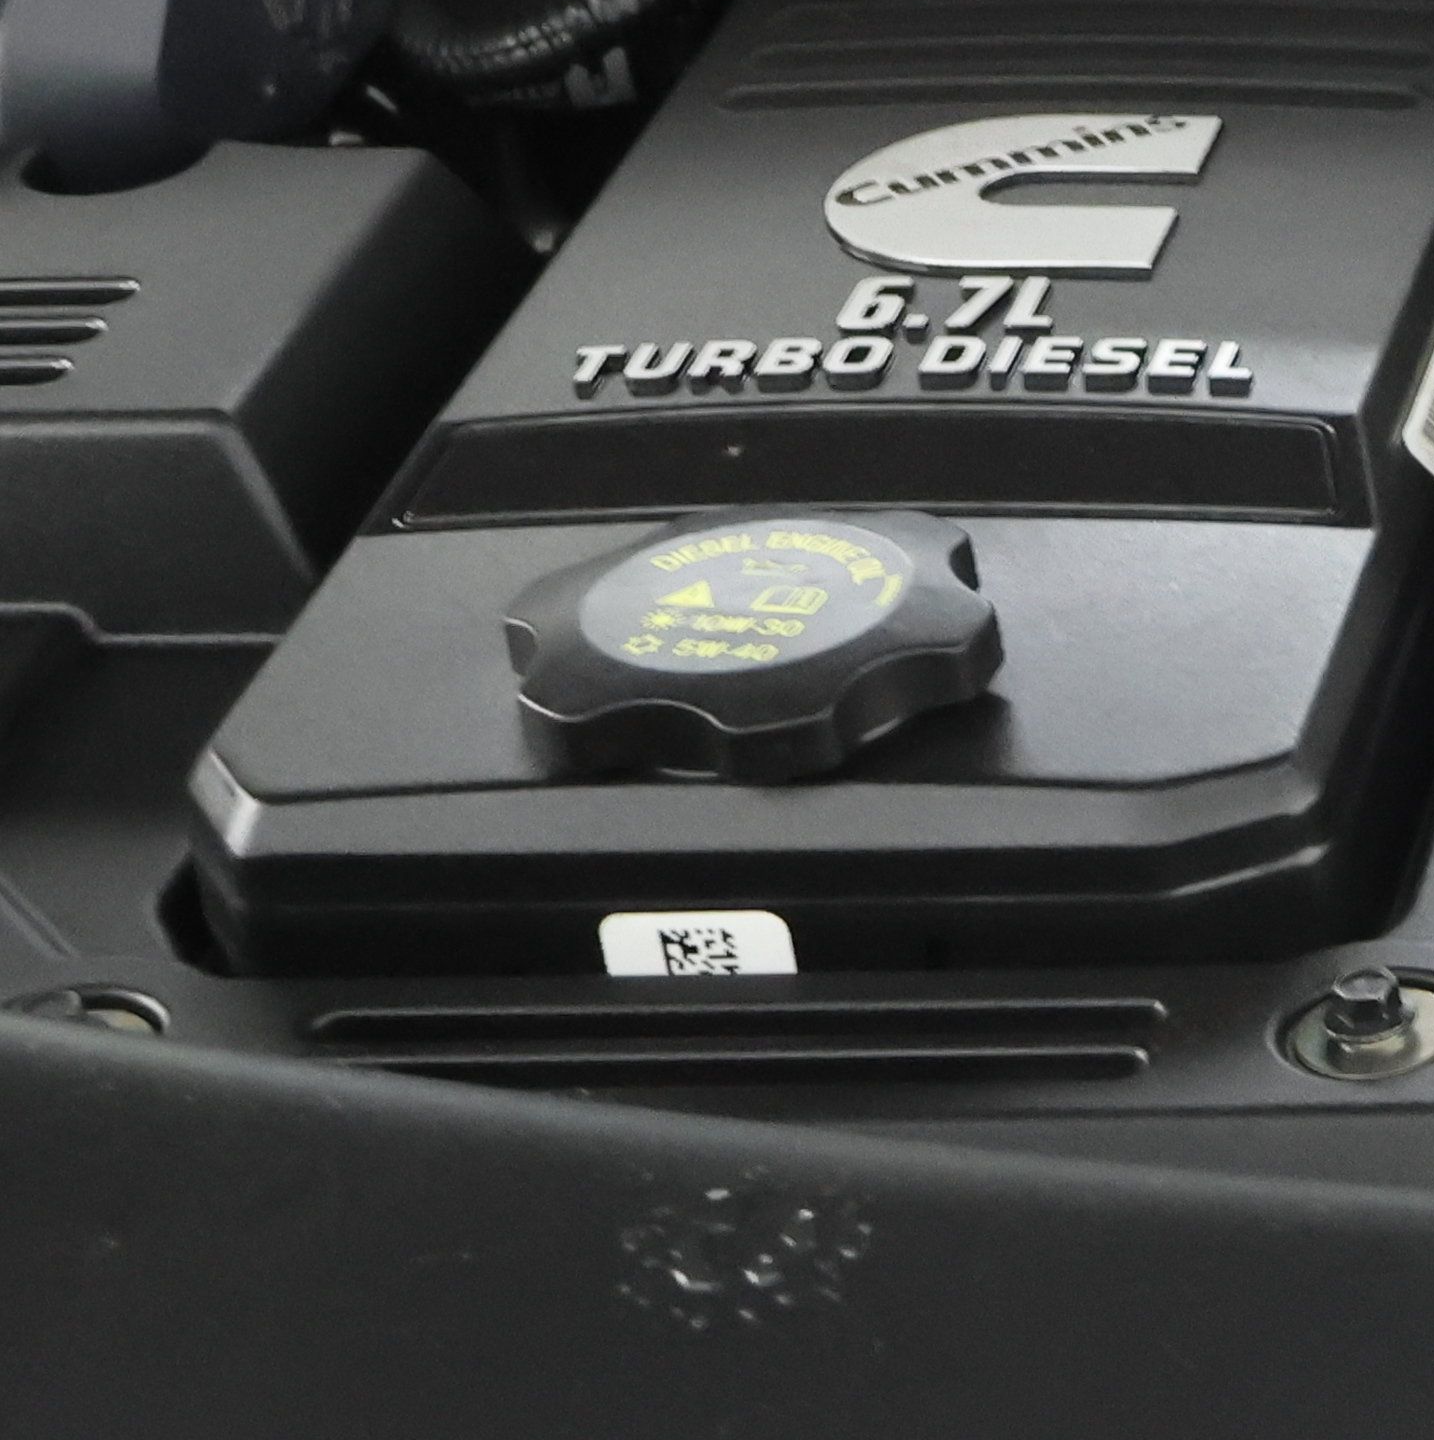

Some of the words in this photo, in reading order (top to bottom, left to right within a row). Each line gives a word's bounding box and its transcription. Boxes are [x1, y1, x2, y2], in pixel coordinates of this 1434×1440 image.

[835, 113, 1188, 207] Cummins
[837, 275, 1055, 335] 6.7L
[573, 335, 895, 397] TURBO
[917, 335, 1254, 398] DIESEL
[650, 532, 758, 572] DIESEL
[766, 530, 871, 565] ENGINE
[671, 638, 780, 662] 5W-40
[690, 614, 806, 638] 10W-30
